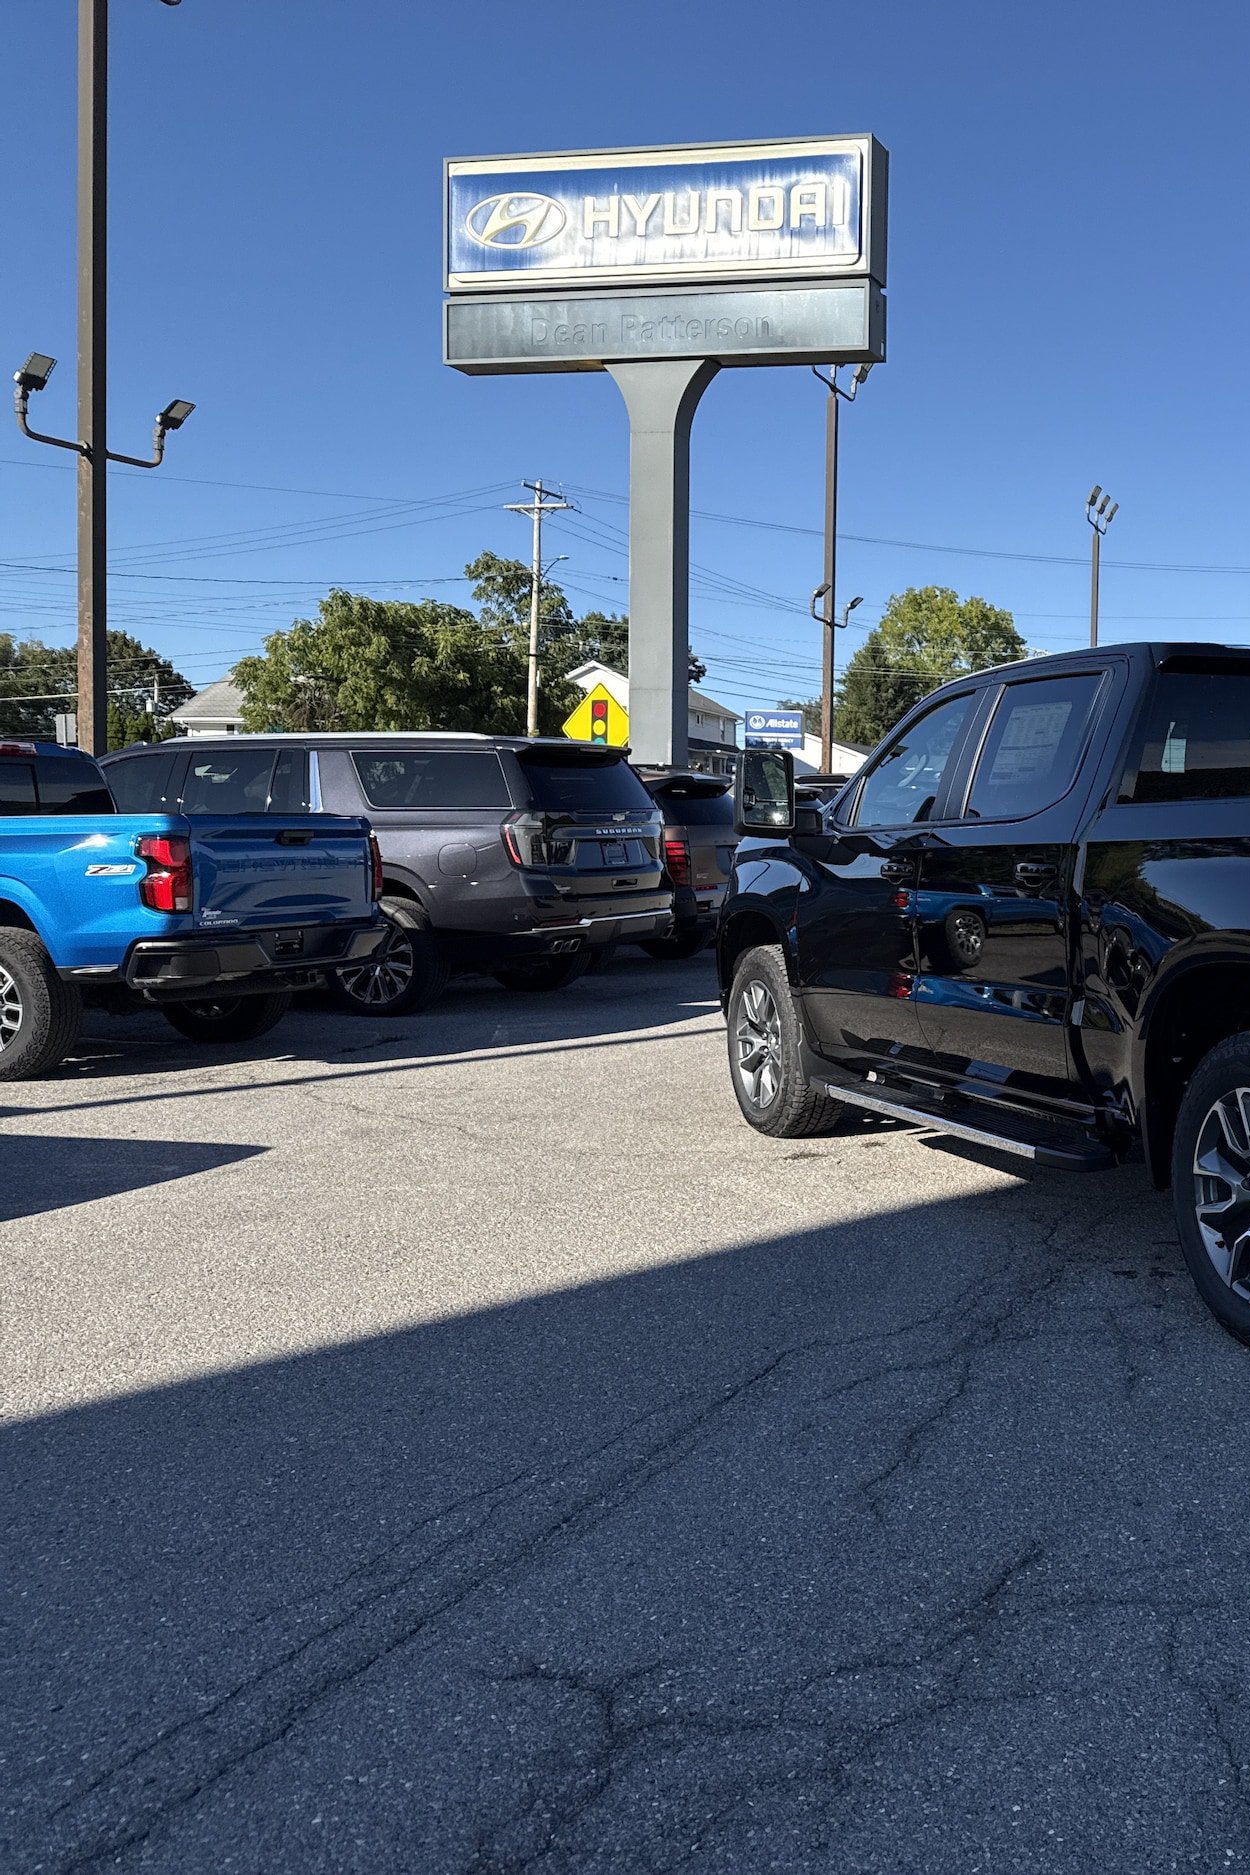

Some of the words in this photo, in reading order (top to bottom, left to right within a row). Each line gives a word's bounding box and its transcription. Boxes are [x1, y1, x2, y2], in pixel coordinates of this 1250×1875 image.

[583, 176, 849, 239] HYUNDAI
[531, 317, 608, 346] Dean
[620, 312, 774, 344] Patterson
[766, 718, 799, 729] Allstate
[198, 918, 239, 927] COLORADO
